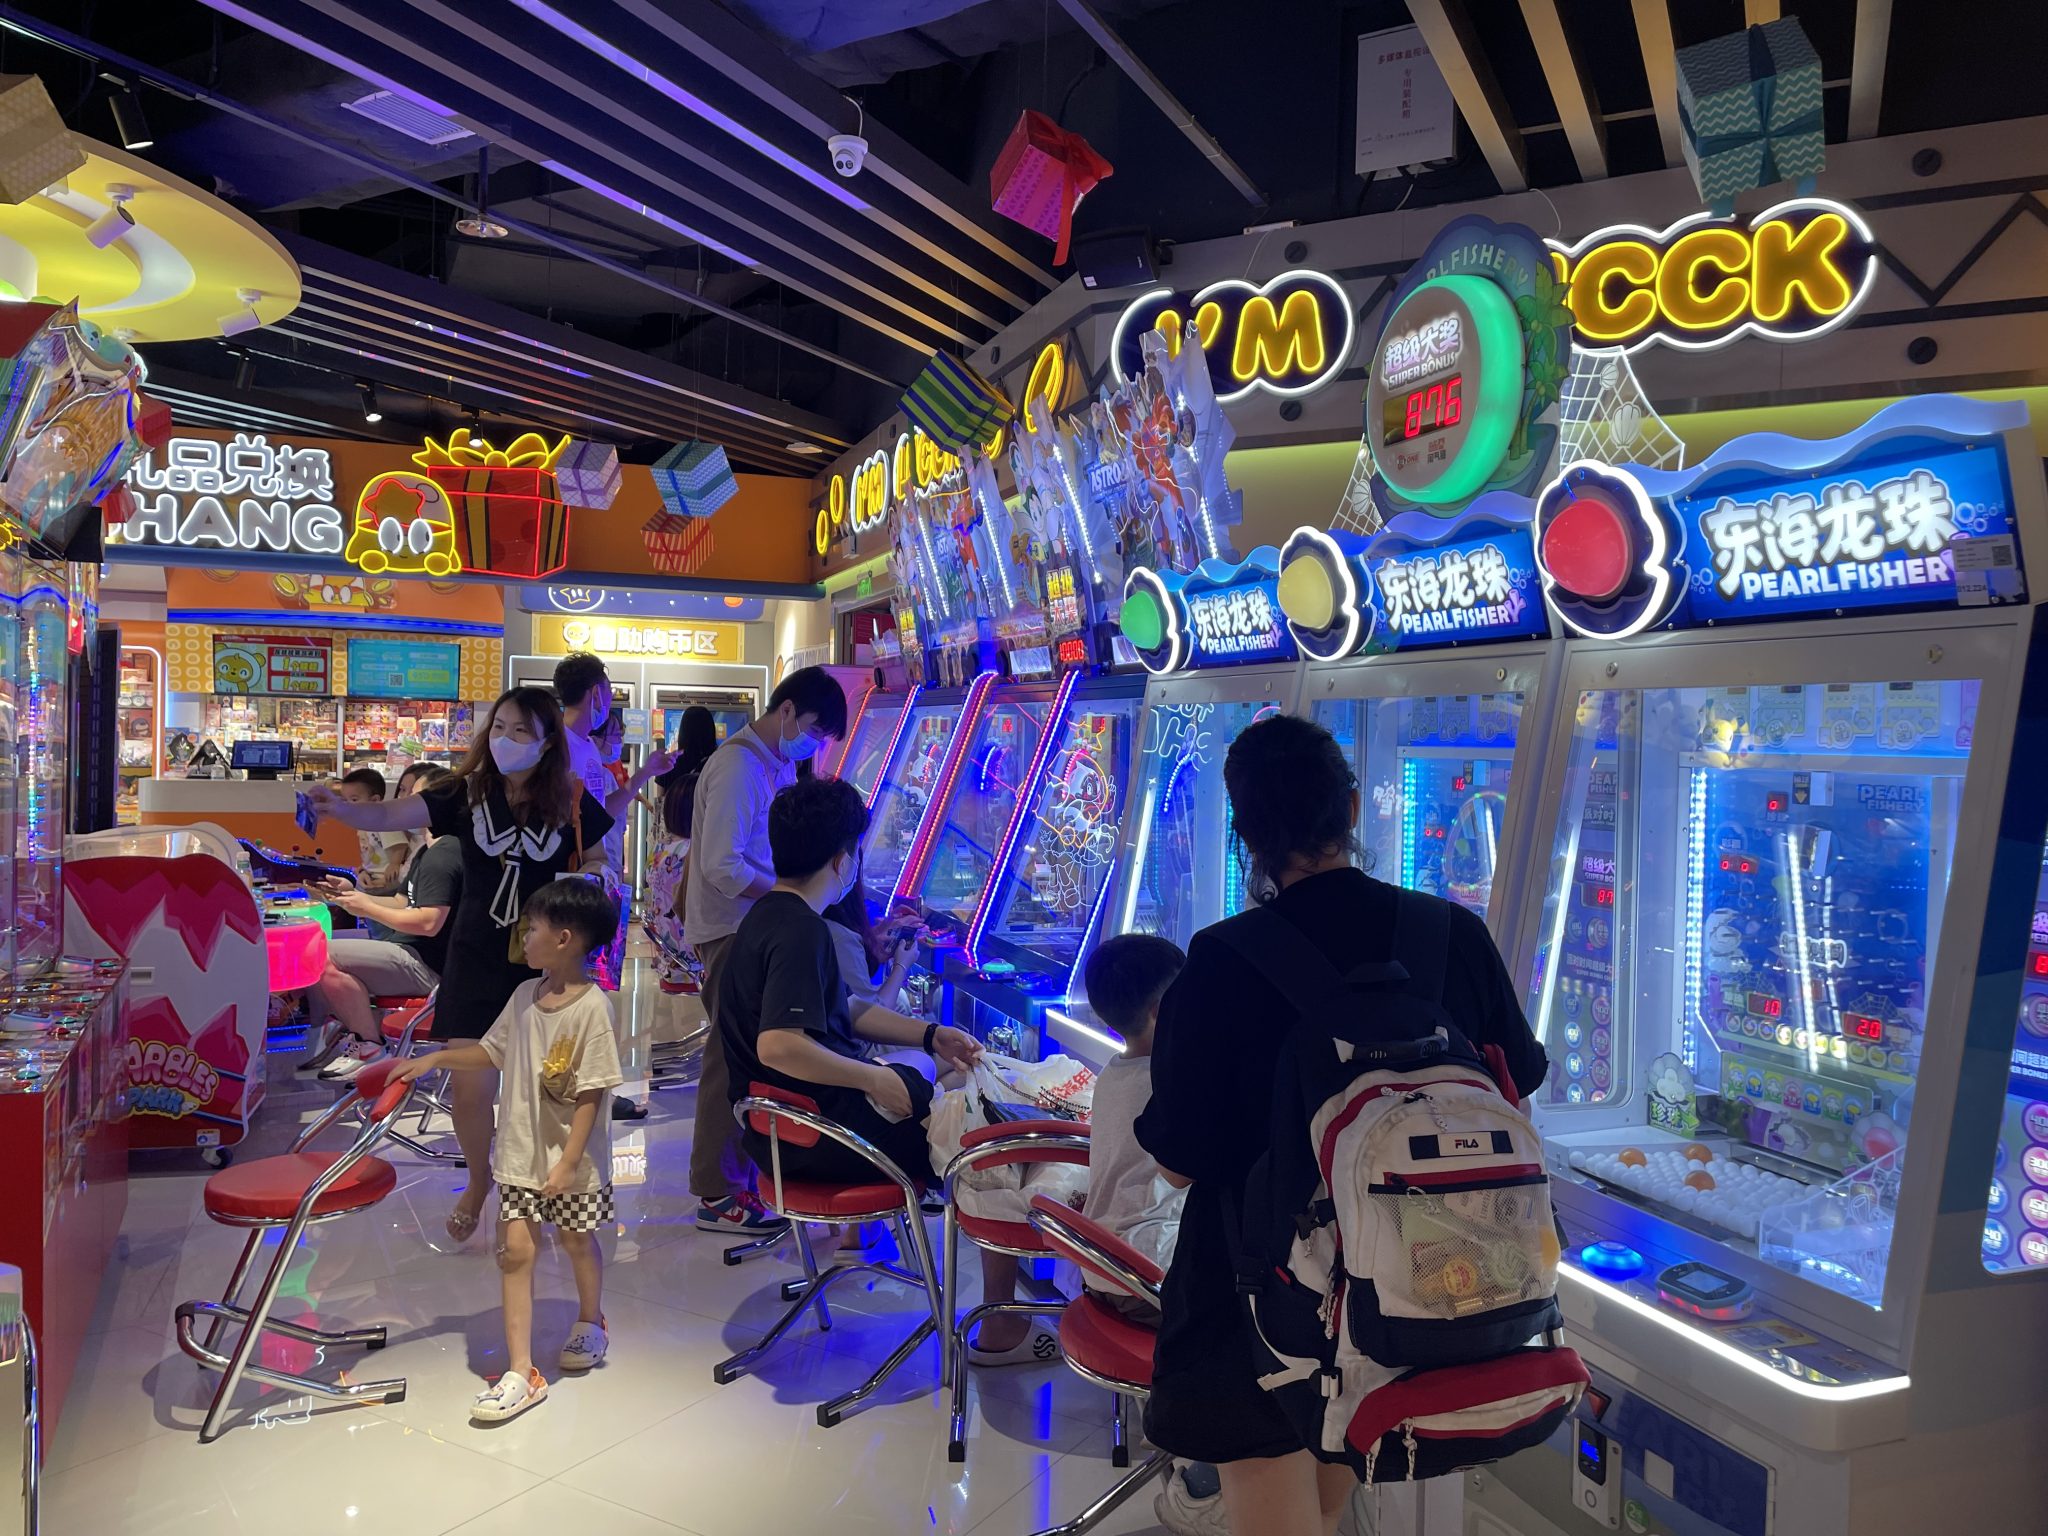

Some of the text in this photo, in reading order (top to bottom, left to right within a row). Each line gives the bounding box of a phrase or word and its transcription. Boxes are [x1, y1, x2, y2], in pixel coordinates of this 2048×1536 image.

[1384, 317, 1461, 373] 超级大奖
[1405, 376, 1463, 439] 876
[109, 491, 343, 553] HANG
[1706, 472, 1961, 595] 东海龙珠
[1379, 546, 1513, 631] 东海龙珠
[1190, 588, 1274, 651] 东海龙珠
[1400, 588, 1527, 634] PEARLFISHERY
[594, 624, 719, 655] 自助购币区
[1206, 622, 1284, 654] PEARLFISHERY
[1859, 784, 1925, 802] PEARL
[1866, 799, 1925, 814] FISHERY
[1763, 999, 1781, 1017] 10
[1856, 1018, 1882, 1039] 20
[1454, 1138, 1479, 1149] FILA
